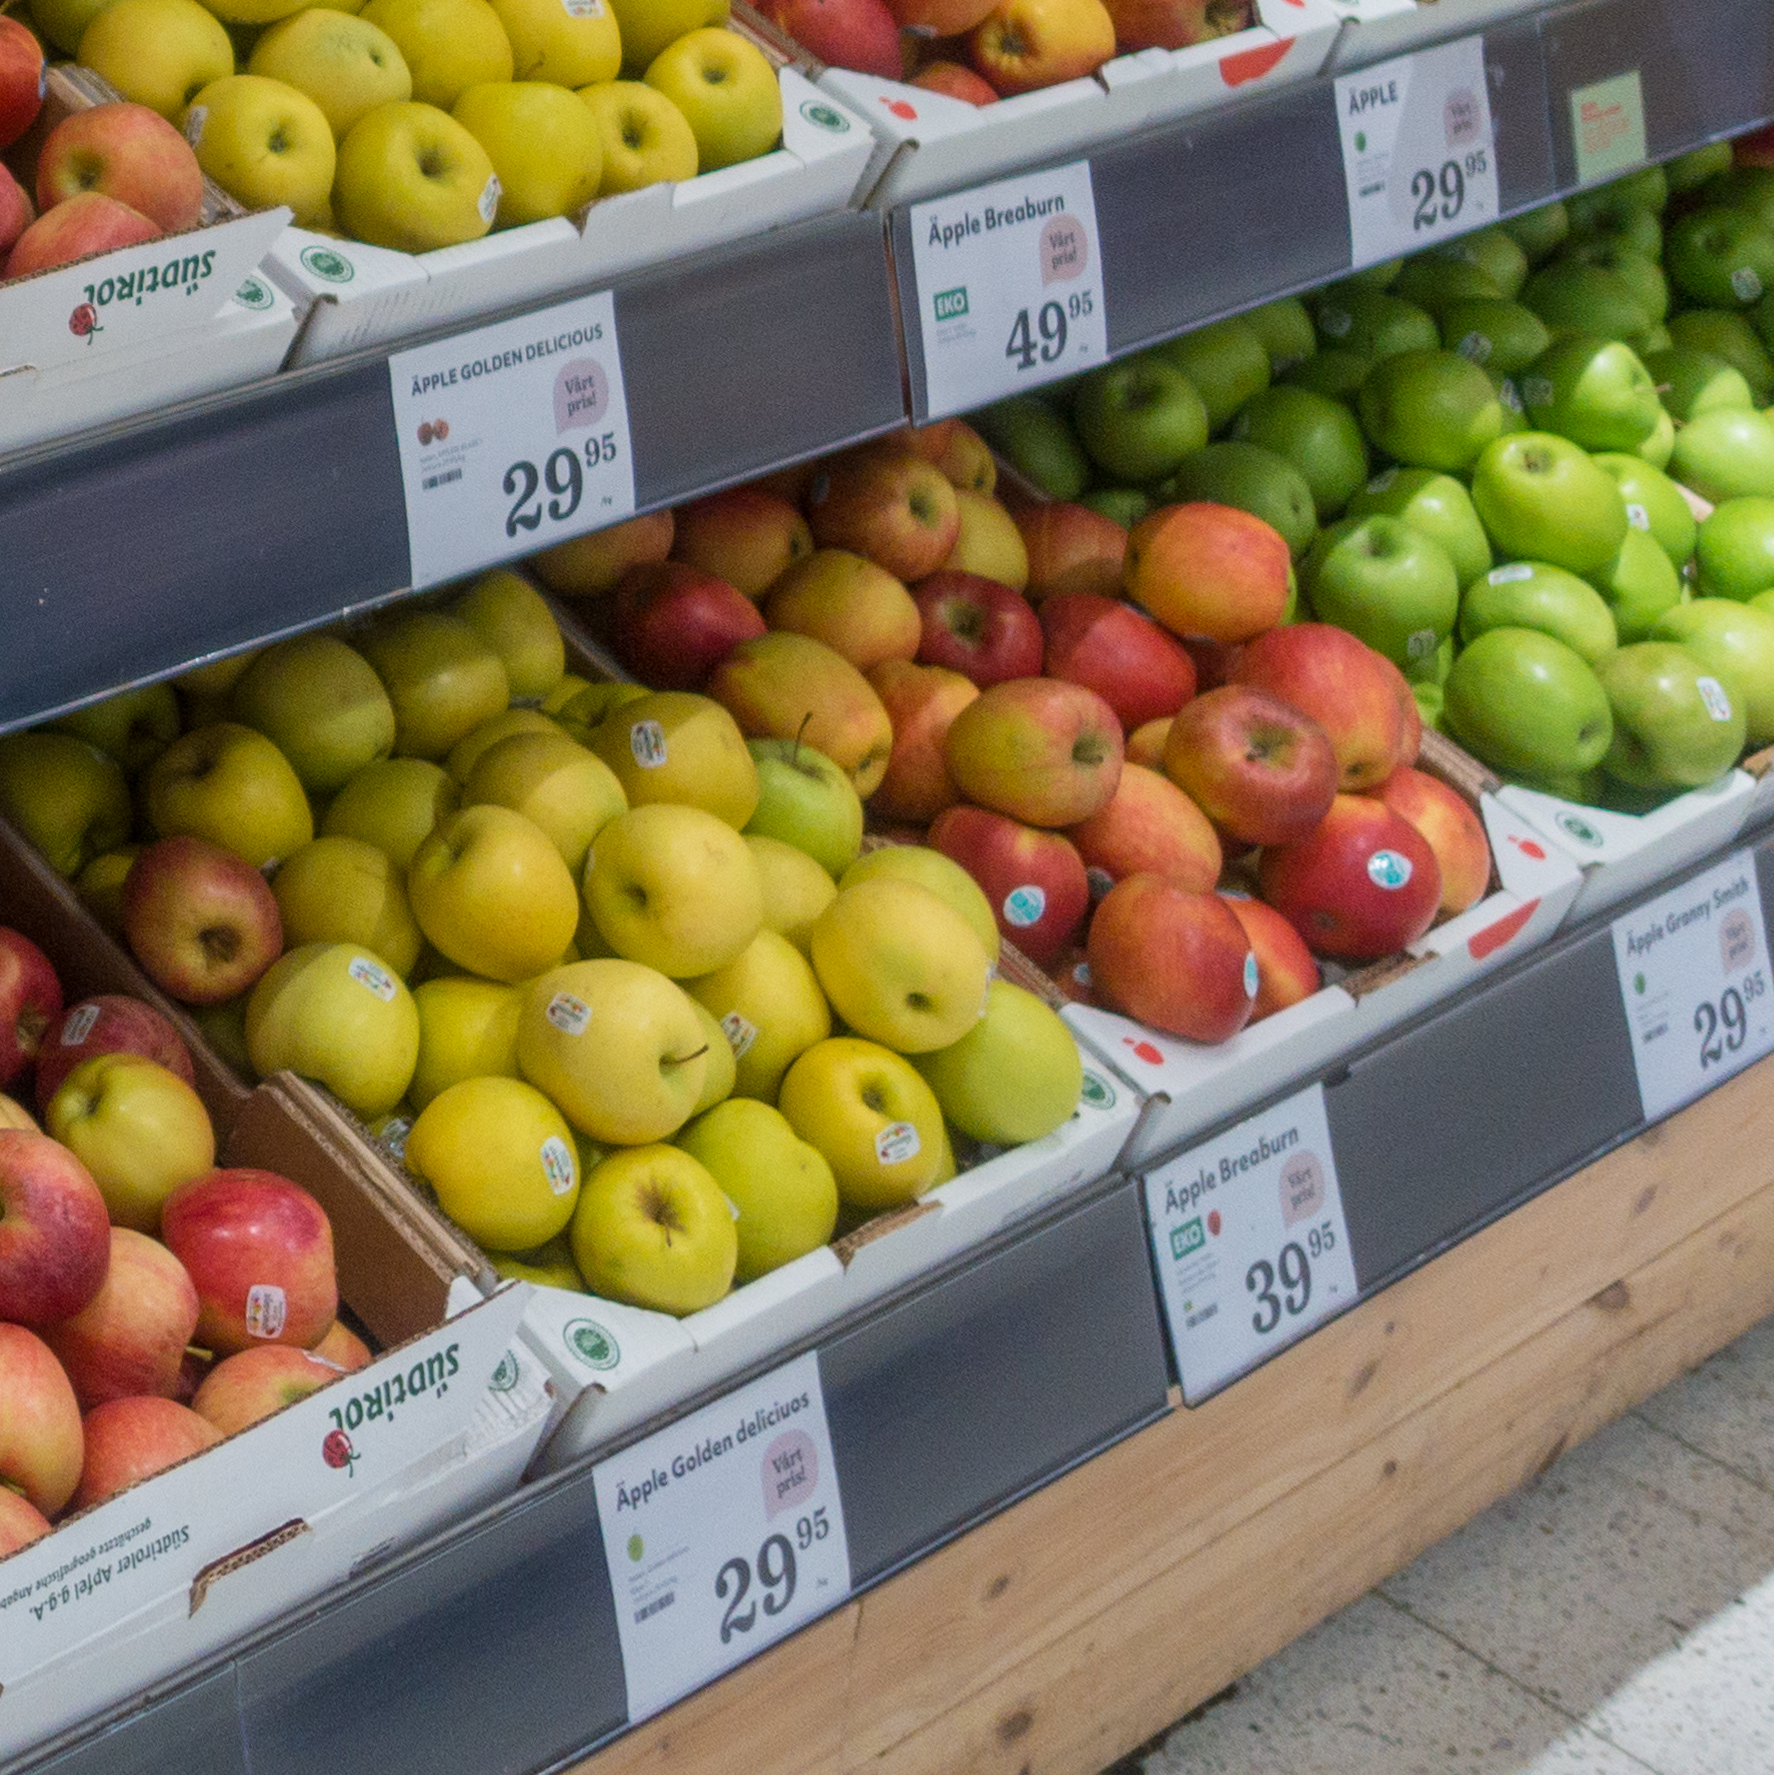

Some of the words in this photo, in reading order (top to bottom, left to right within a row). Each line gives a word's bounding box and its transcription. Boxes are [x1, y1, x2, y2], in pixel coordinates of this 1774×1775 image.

[1349, 81, 1399, 117] ÄPPLE
[929, 211, 981, 248] Äpple
[985, 194, 1065, 230] Breaburn
[1411, 158, 1468, 232] 29
[1049, 229, 1076, 251] Vårt
[936, 290, 967, 319] EKO
[1006, 299, 1068, 372] 49
[1068, 289, 1094, 317] 95
[411, 371, 459, 397] ÄPPLE
[461, 350, 524, 381] GOLDEN
[525, 325, 604, 364] DELICIOUS
[564, 376, 594, 396] Vårt
[567, 393, 597, 419] pris!
[502, 447, 585, 538] 29
[585, 432, 618, 469] 95
[1627, 921, 1665, 957] Äpple
[1666, 901, 1711, 939] Granny
[1713, 879, 1750, 910] Smith
[1694, 986, 1748, 1070] 29
[1164, 1169, 1218, 1216] Äpple
[1219, 1125, 1300, 1185] Breaburn
[1245, 1241, 1313, 1336] 39
[1309, 1220, 1337, 1260] 95
[616, 1470, 669, 1515] Äpple
[671, 1437, 734, 1478] Golden
[771, 1449, 804, 1476] Vårt
[776, 1469, 810, 1502] pris!
[99, 1518, 152, 1556] geschützte
[117, 1525, 191, 1575] Südtiroler
[33, 1545, 98, 1595] geografische
[74, 1554, 113, 1600] Apfel
[715, 1533, 797, 1646] 29
[796, 1506, 831, 1551] 95
